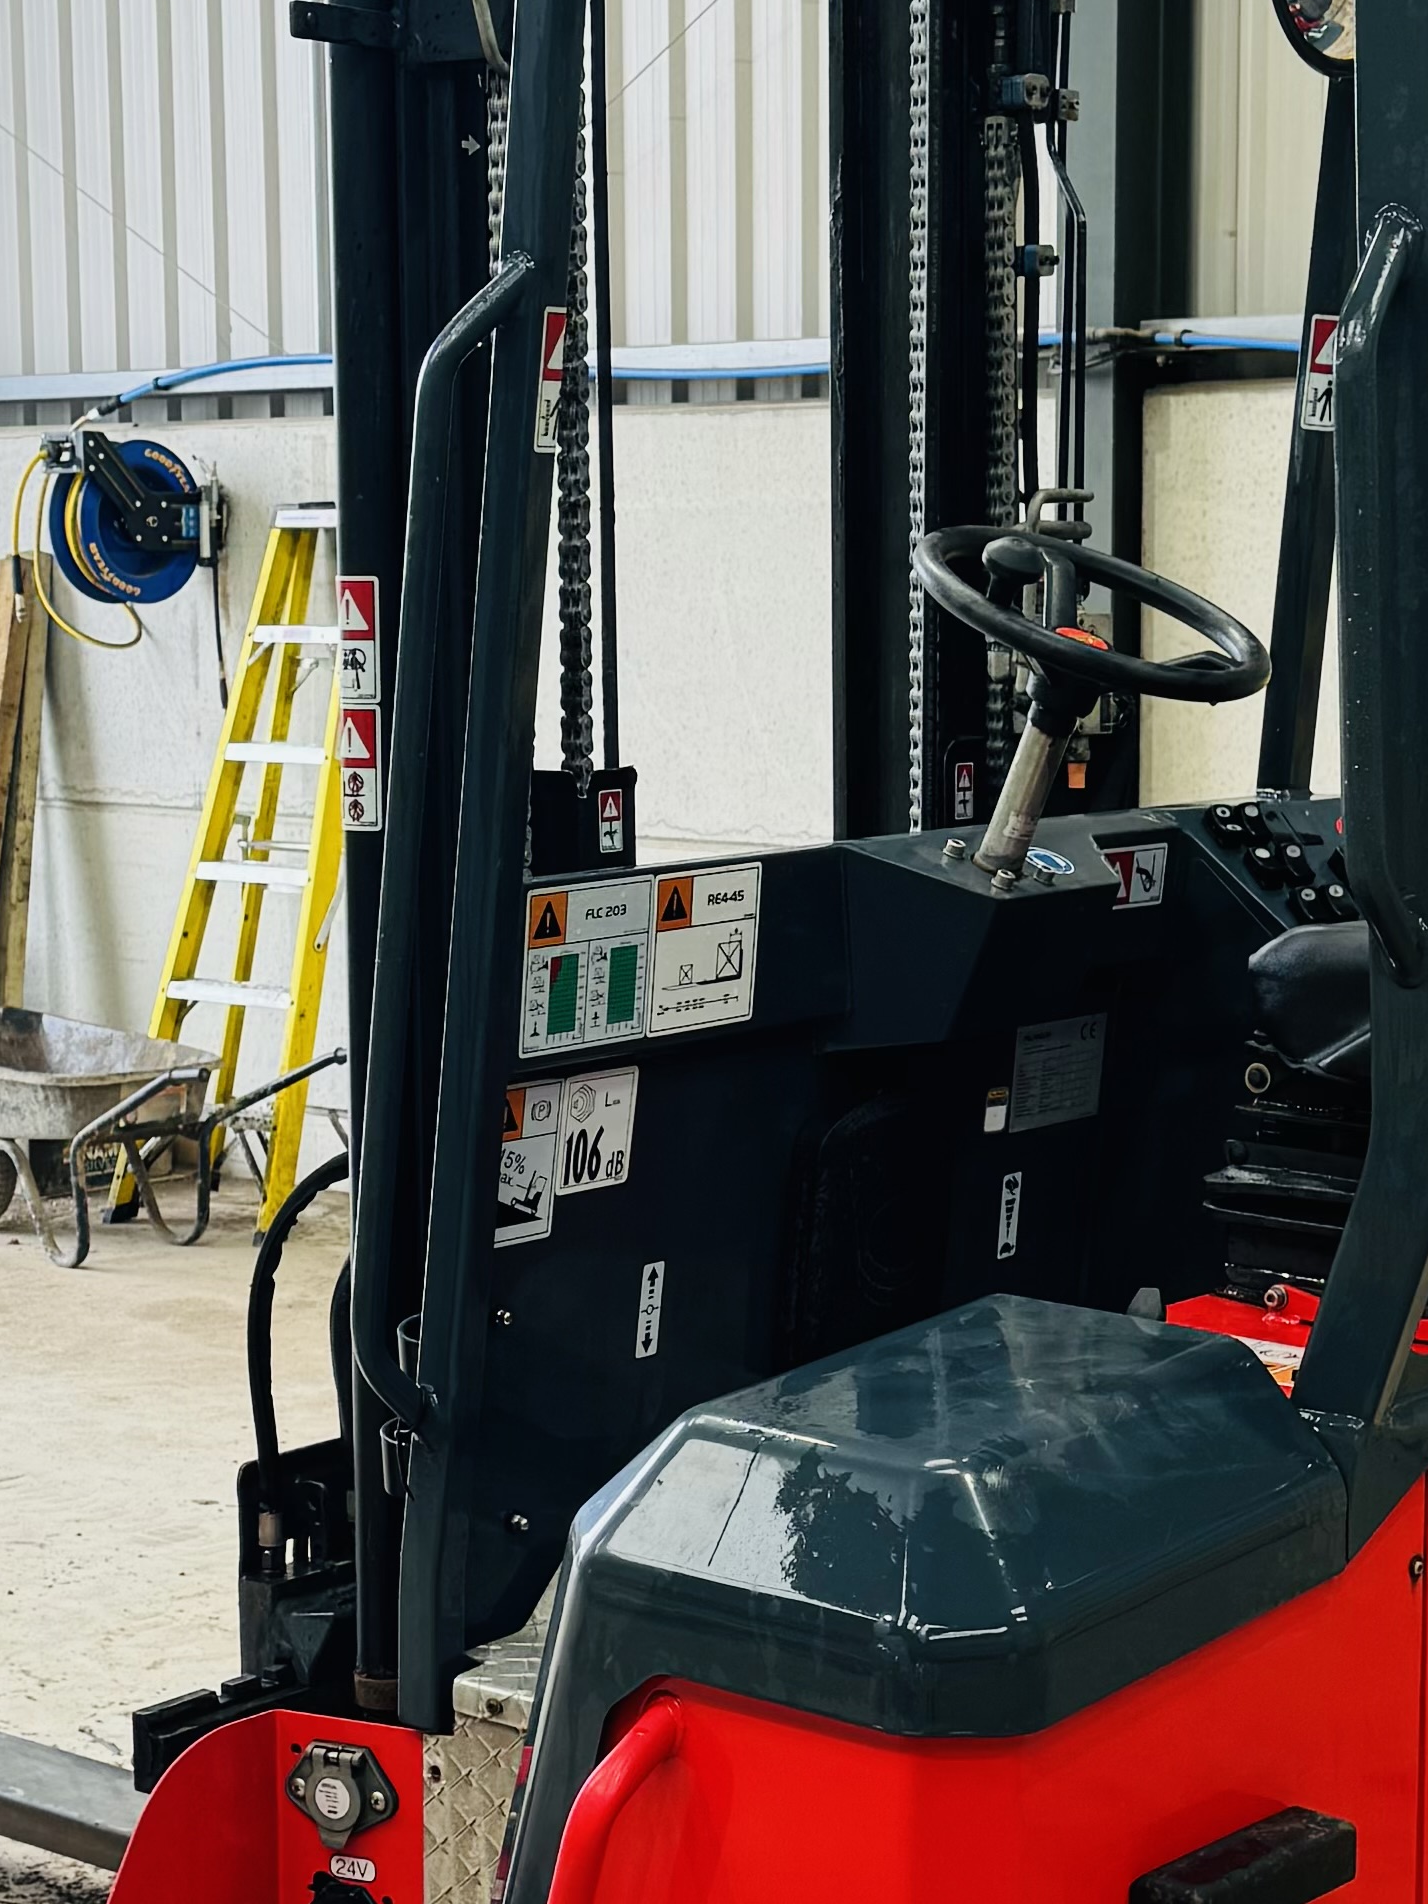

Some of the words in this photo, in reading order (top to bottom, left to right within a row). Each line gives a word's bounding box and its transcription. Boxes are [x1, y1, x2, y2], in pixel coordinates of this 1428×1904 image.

[585, 907, 603, 920] FLC
[606, 904, 627, 916] 203
[563, 1125, 605, 1186] 106
[605, 1150, 624, 1178] dB
[335, 1857, 369, 1878] 24V
